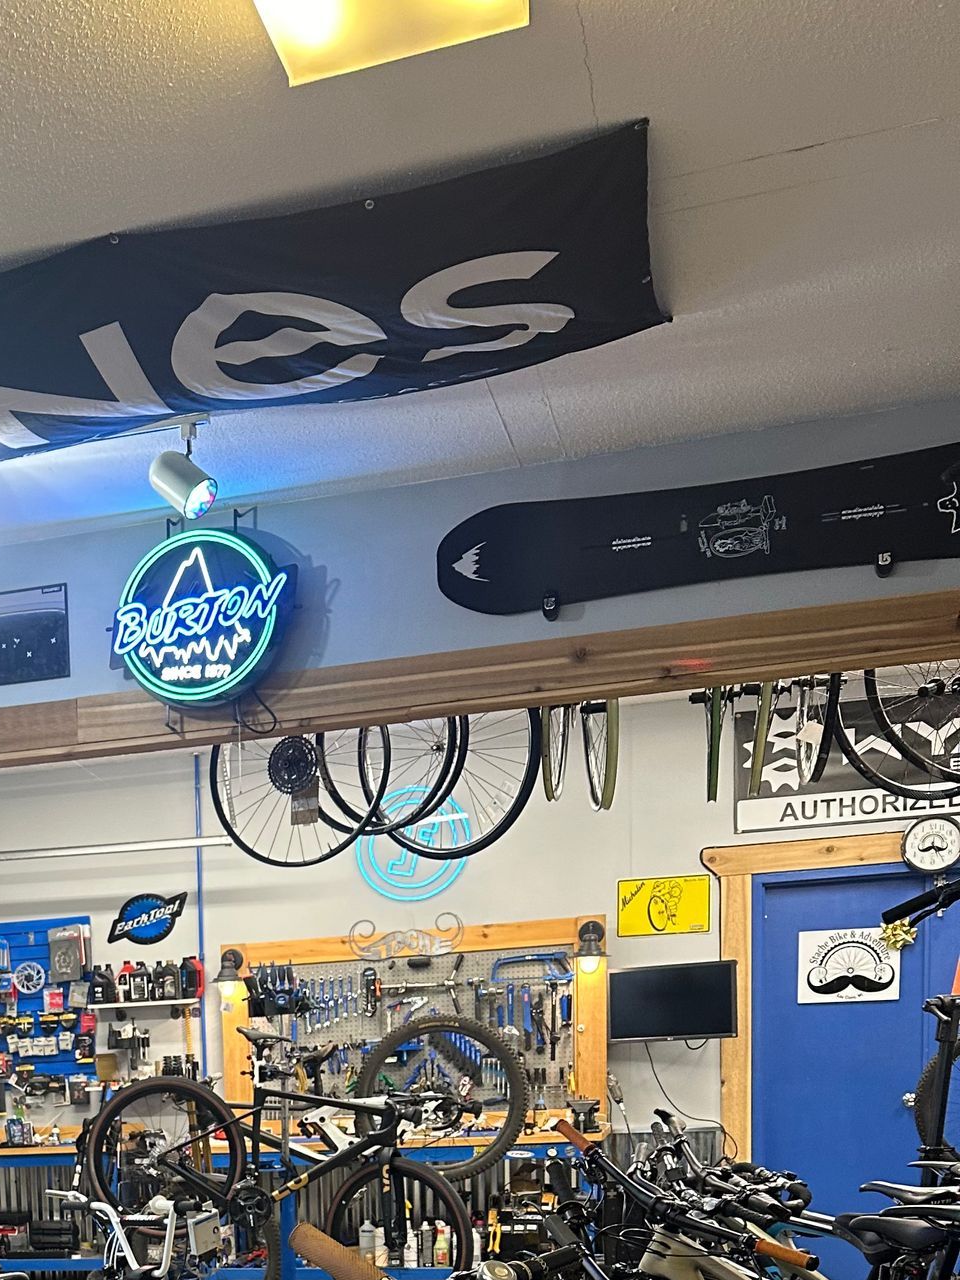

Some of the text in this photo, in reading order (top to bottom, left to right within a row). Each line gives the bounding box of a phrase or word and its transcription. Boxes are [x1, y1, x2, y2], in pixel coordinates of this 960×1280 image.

[114, 572, 287, 655] BURTON
[809, 930, 891, 965] Stache Bike & Adventure
